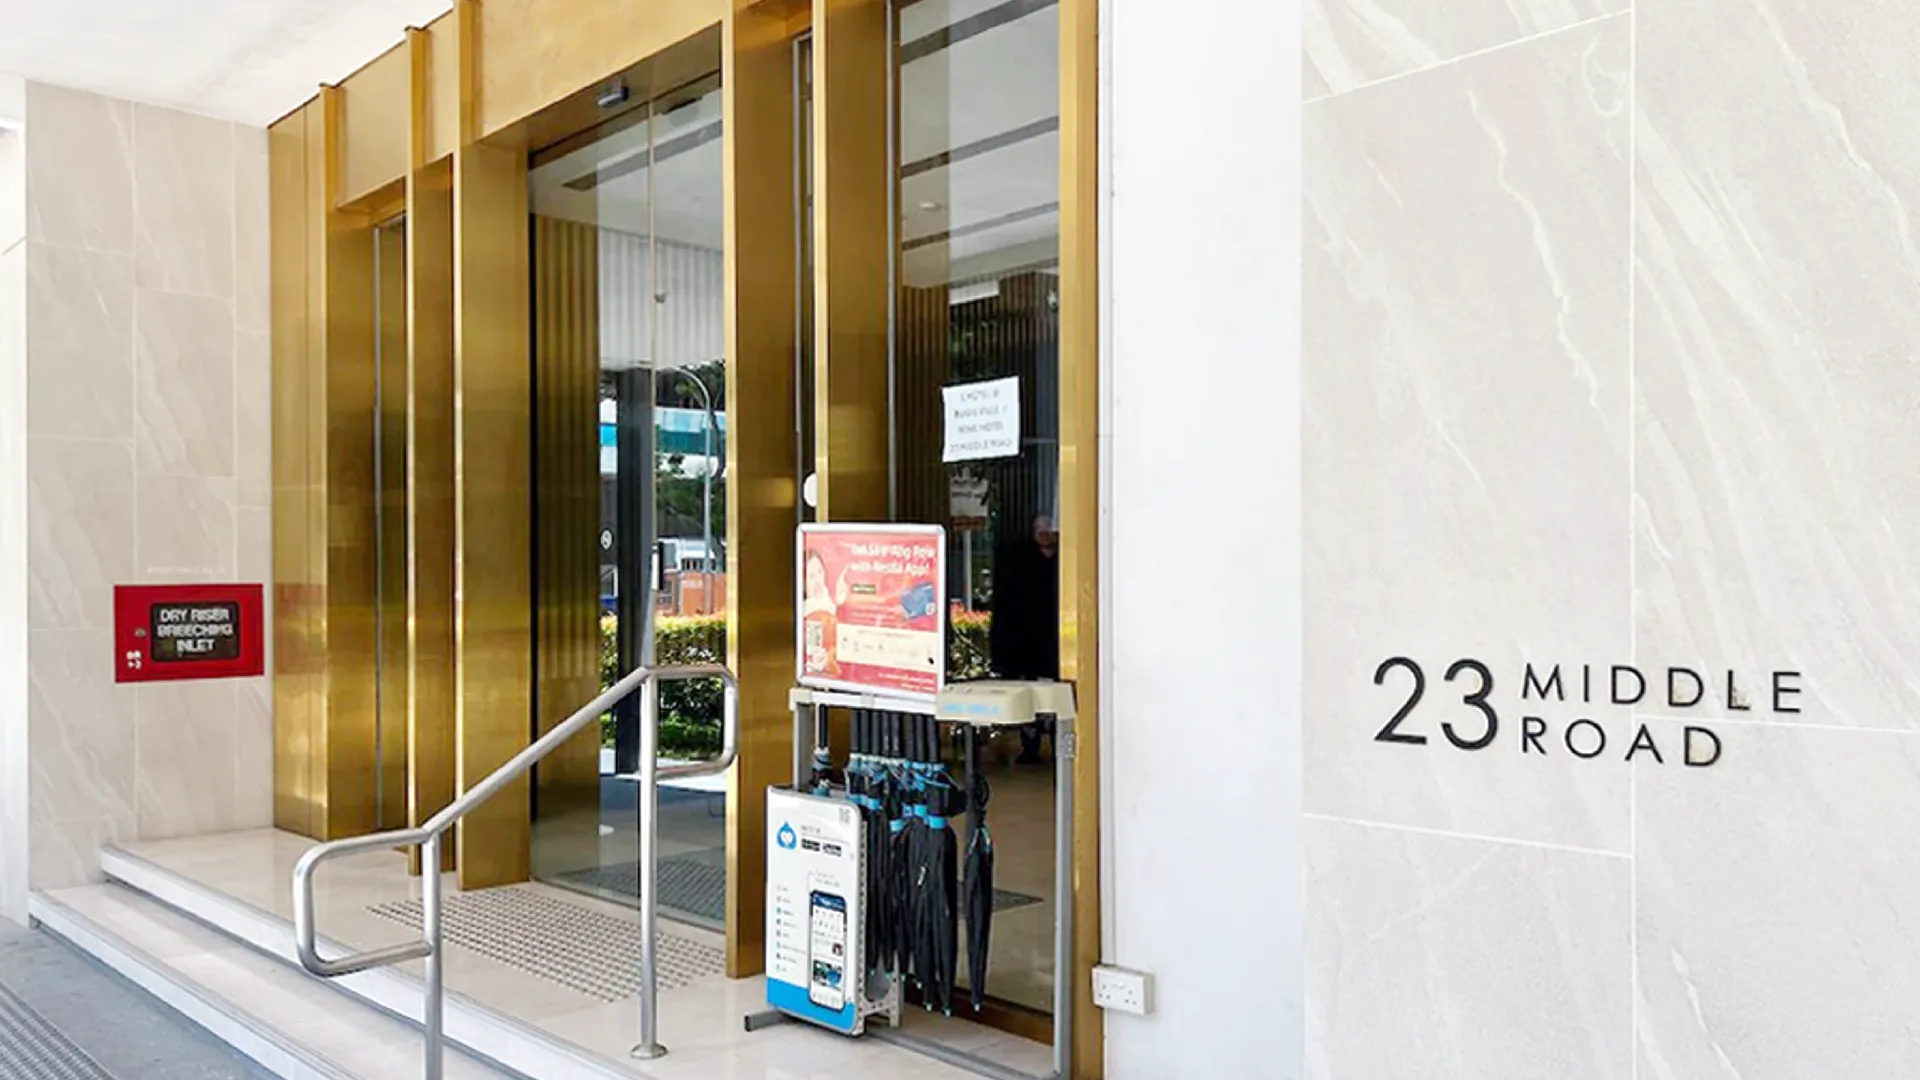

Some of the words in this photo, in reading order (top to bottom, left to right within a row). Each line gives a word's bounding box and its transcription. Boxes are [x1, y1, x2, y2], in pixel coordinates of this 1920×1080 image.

[160, 609, 187, 622] DRY
[192, 608, 229, 621] RISER
[157, 624, 233, 637] BREECHING
[177, 639, 214, 653] INLET
[1373, 656, 1498, 751] 23
[1521, 663, 1802, 713] MIDDLE
[1521, 716, 1722, 767] ROAD
